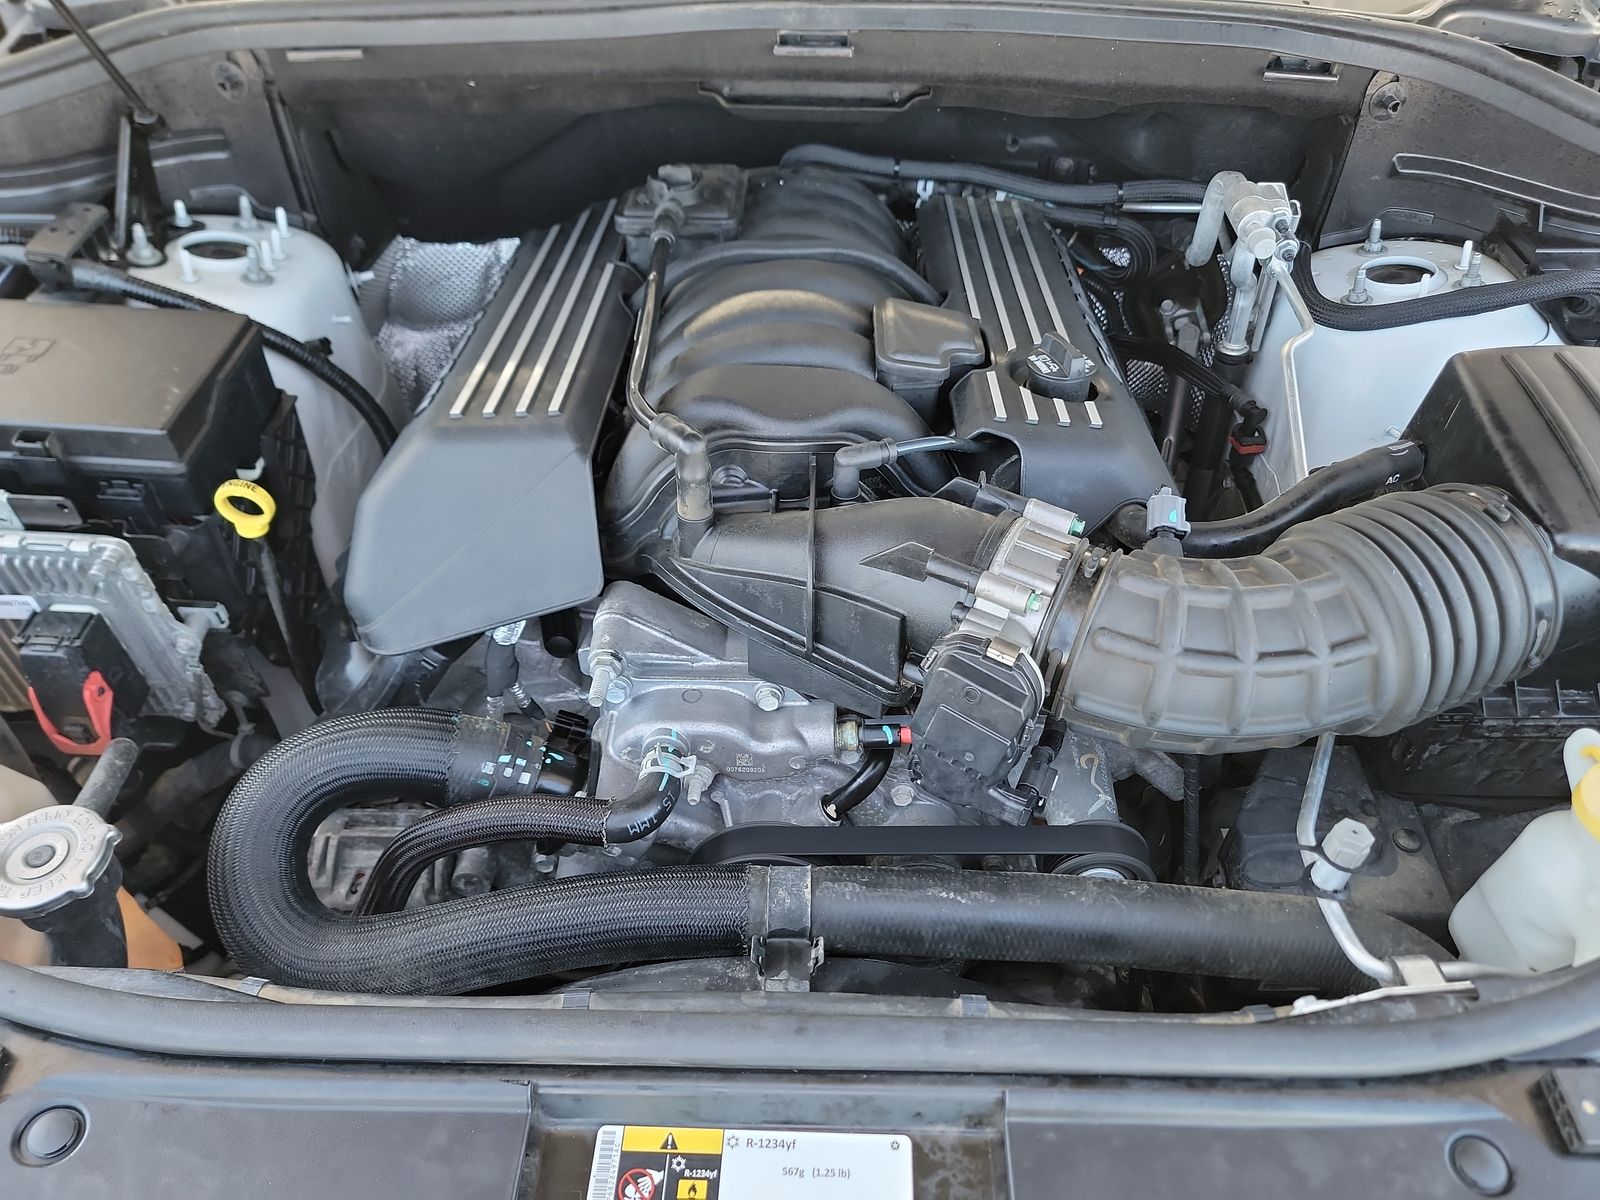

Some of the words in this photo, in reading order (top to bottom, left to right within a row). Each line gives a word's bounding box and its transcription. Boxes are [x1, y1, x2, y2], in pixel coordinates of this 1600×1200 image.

[1385, 474, 1400, 486] AC
[746, 1138, 797, 1151] R-1234yf
[781, 1167, 805, 1179] 567g
[812, 1167, 836, 1179] (1.25
[838, 1168, 851, 1180] lb)
